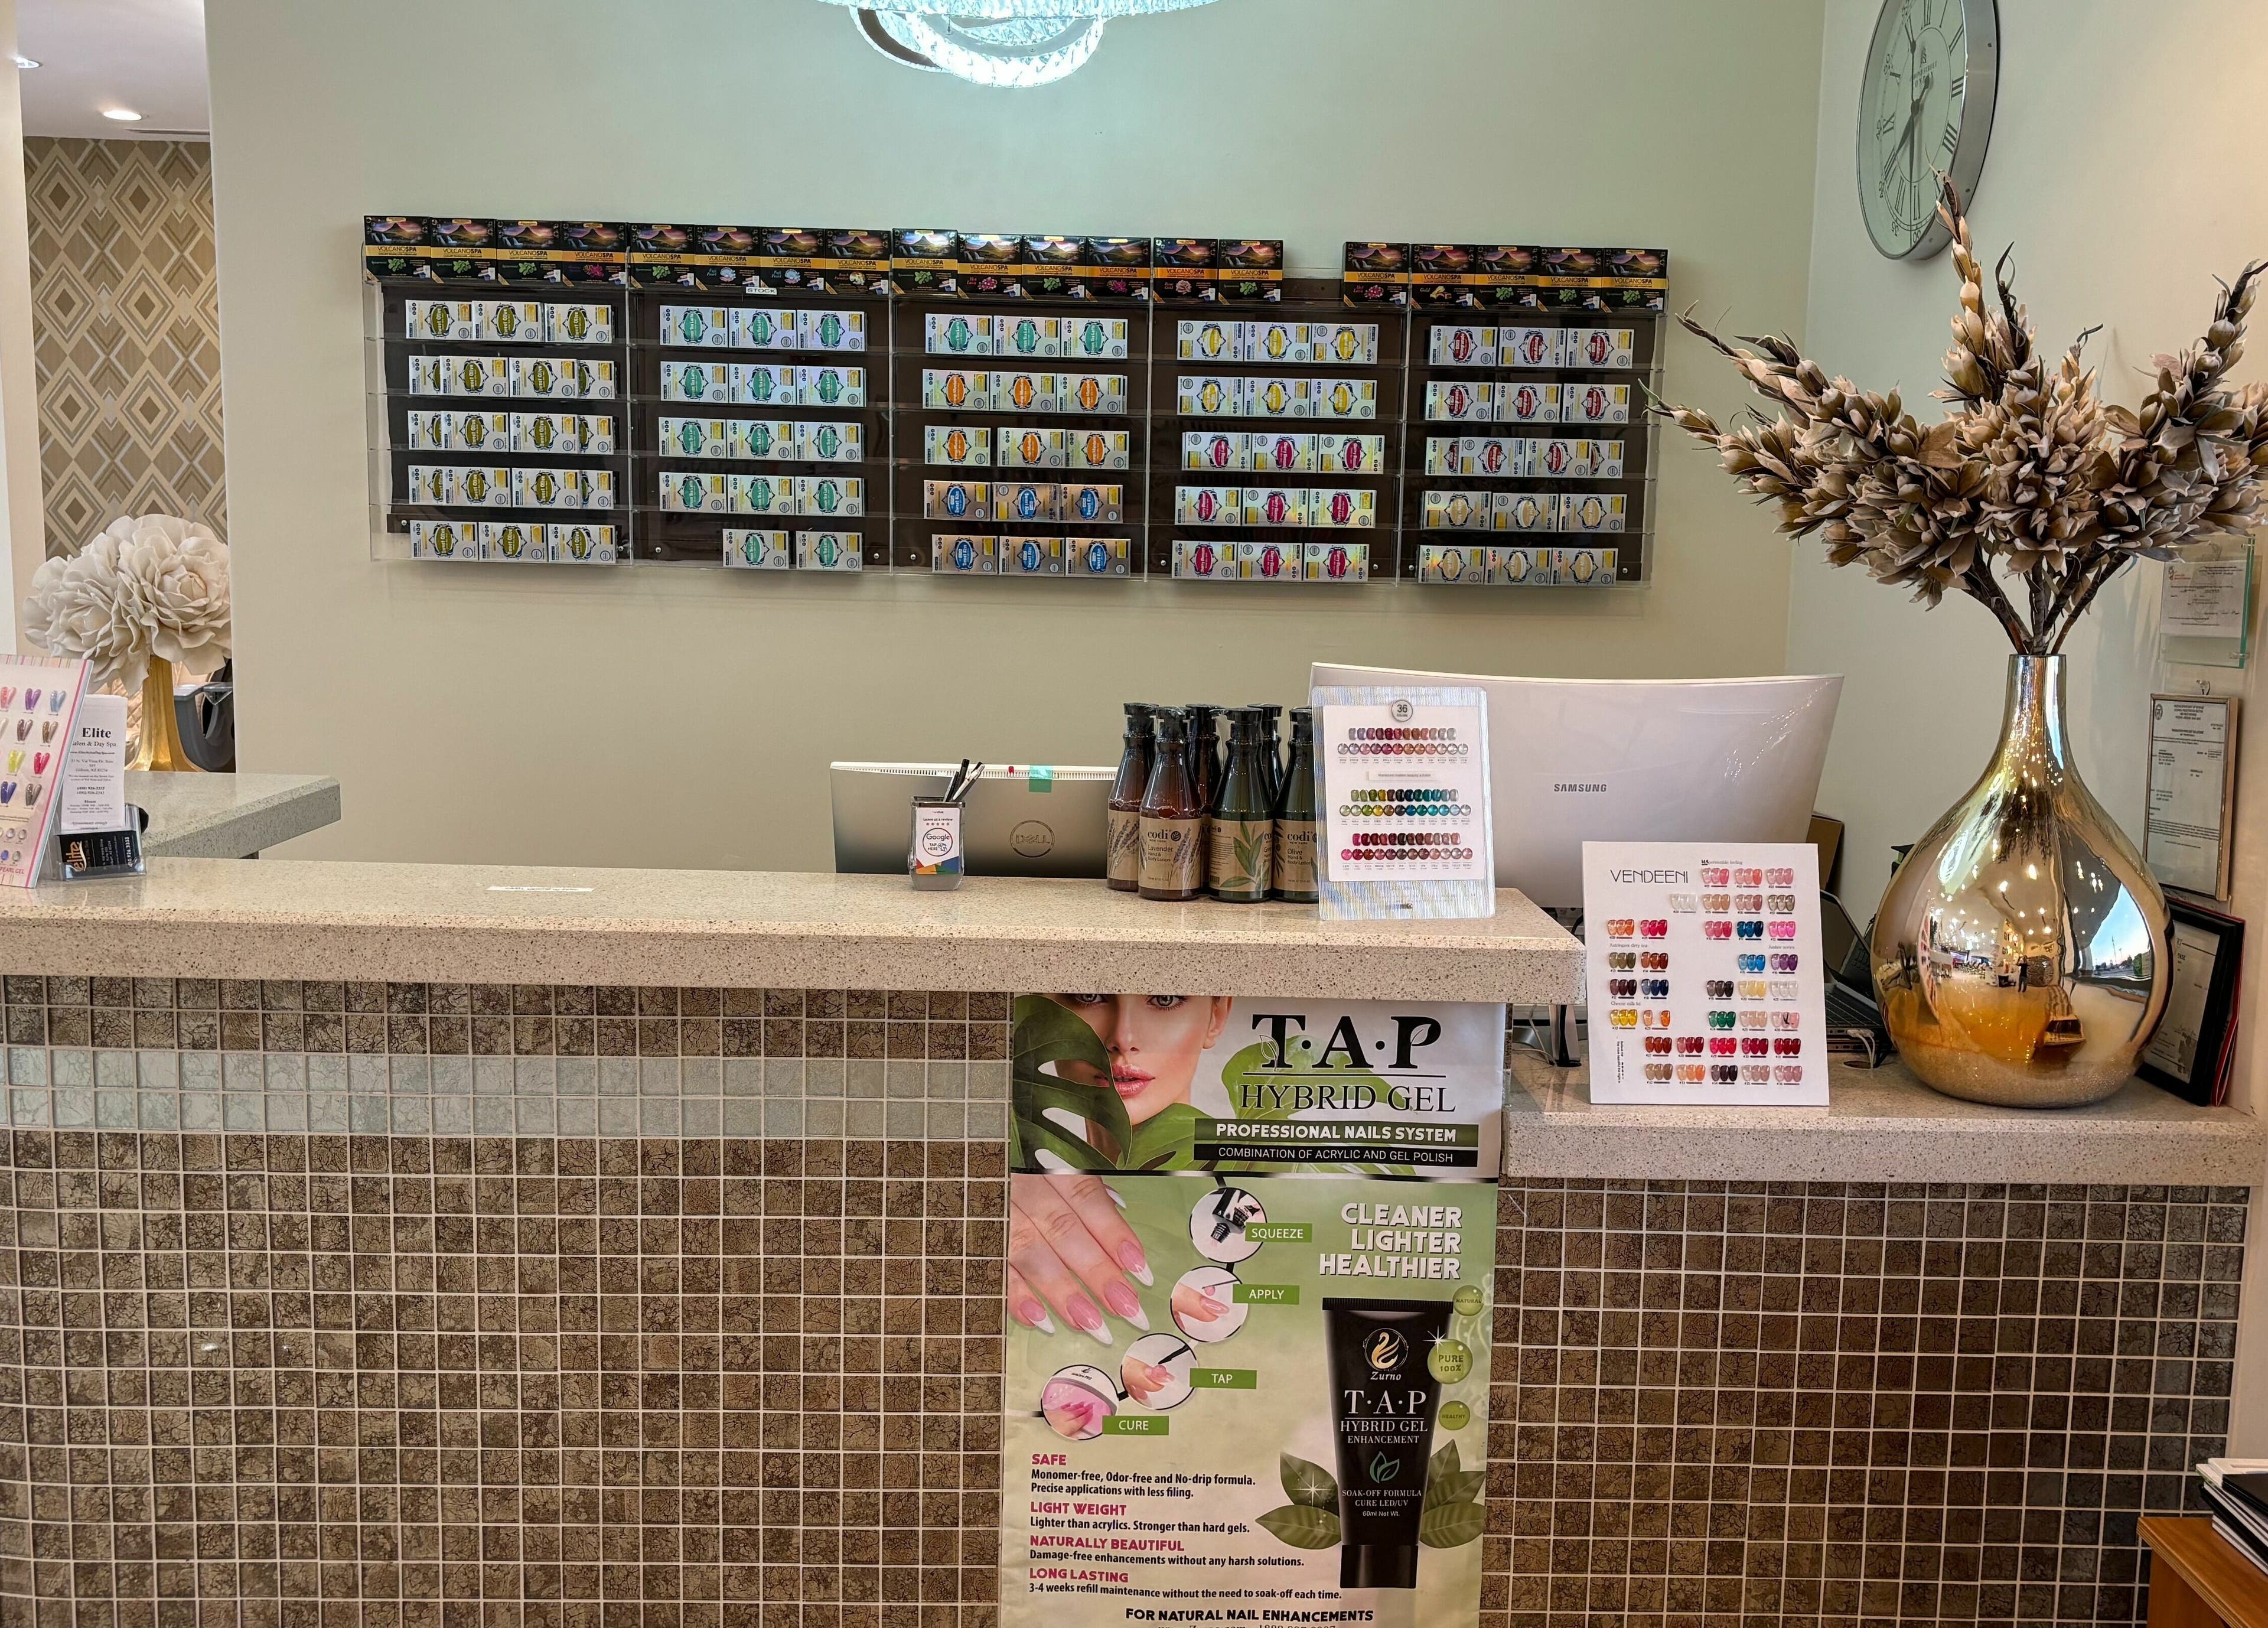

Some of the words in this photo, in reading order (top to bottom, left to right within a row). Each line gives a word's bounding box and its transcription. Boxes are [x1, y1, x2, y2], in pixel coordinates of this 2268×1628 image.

[1396, 704, 1408, 713] 36
[82, 728, 112, 738] Elite
[1554, 783, 1606, 792] SAMSUNG
[1148, 829, 1168, 839] codi
[1288, 831, 1309, 841] codi
[1610, 870, 1688, 883] VENDEENI
[1240, 1084, 1377, 1110] HYBRID
[1387, 1086, 1456, 1112] GEL
[1216, 1124, 1341, 1139] PROFESSIONAL
[1344, 1125, 1391, 1141] NAILS
[1395, 1126, 1456, 1142] SYSTEM
[1218, 1147, 1295, 1159] COMBINATION
[1298, 1148, 1312, 1159] OF
[1315, 1149, 1360, 1160] ACRYLIC
[1363, 1150, 1386, 1160] AND
[1389, 1151, 1410, 1161] GEL
[1413, 1151, 1453, 1163] POLISH
[1341, 1203, 1463, 1229] CLEANER
[1251, 1228, 1304, 1239] SQUEEZE
[1351, 1229, 1462, 1254] LIGHTER
[1319, 1253, 1461, 1280] HEALTHIER
[1249, 1290, 1285, 1300] APPLY
[1438, 1355, 1464, 1363] PURE
[1211, 1373, 1233, 1385] TAP
[1370, 1372, 1402, 1381] Zurno
[1119, 1420, 1149, 1431] CURE
[1340, 1421, 1395, 1432] HYBRID
[1400, 1421, 1428, 1432] GEL
[1347, 1435, 1420, 1444] ENHANCEMENT
[1032, 1454, 1067, 1466] SAFE
[1031, 1469, 1103, 1483] Monomer-free,
[1106, 1471, 1152, 1484] Odor-free
[1154, 1473, 1172, 1484] and
[1175, 1473, 1211, 1487] No-drip
[1214, 1474, 1256, 1486] formula.
[1031, 1483, 1063, 1493] Precise
[1065, 1483, 1122, 1496] applications
[1123, 1486, 1145, 1496] with
[1148, 1487, 1165, 1497] less
[1166, 1487, 1194, 1499] filing.
[1031, 1501, 1070, 1514] LIGHT
[1073, 1503, 1127, 1516] WEIGHT
[1030, 1516, 1065, 1529] Lighter
[1067, 1518, 1090, 1529] than
[1092, 1519, 1130, 1532] acrylics.
[1133, 1520, 1175, 1533] Stronger
[1178, 1522, 1200, 1532] than
[1203, 1522, 1225, 1532] hard
[1227, 1523, 1250, 1535] gels.
[1030, 1535, 1108, 1549] NATURALLY
[1111, 1538, 1185, 1551] BEAUTIFUL
[1030, 1549, 1092, 1561] Damage-free
[1094, 1552, 1165, 1565] enhancements
[1168, 1555, 1207, 1565] without
[1208, 1558, 1226, 1568] any
[1228, 1556, 1255, 1566] harsh
[1257, 1556, 1304, 1566] solutions.
[1029, 1568, 1067, 1579] LONG
[1070, 1570, 1129, 1583] LASTING
[1029, 1583, 1044, 1593] 3-4
[1046, 1583, 1074, 1593] weeks
[1077, 1583, 1098, 1594] refill
[1100, 1585, 1160, 1598] maintenance
[1162, 1588, 1200, 1598] without
[1201, 1588, 1217, 1598] the
[1218, 1589, 1241, 1598] need
[1244, 1590, 1253, 1598] to
[1255, 1588, 1293, 1598] soak-off
[1294, 1590, 1315, 1599] each
[1318, 1590, 1342, 1599] time.
[1126, 1608, 1155, 1621] FOR
[1158, 1609, 1223, 1622] NATURAL
[1226, 1609, 1259, 1621] NAIL
[1262, 1610, 1374, 1623] ENHANCEMENTS
